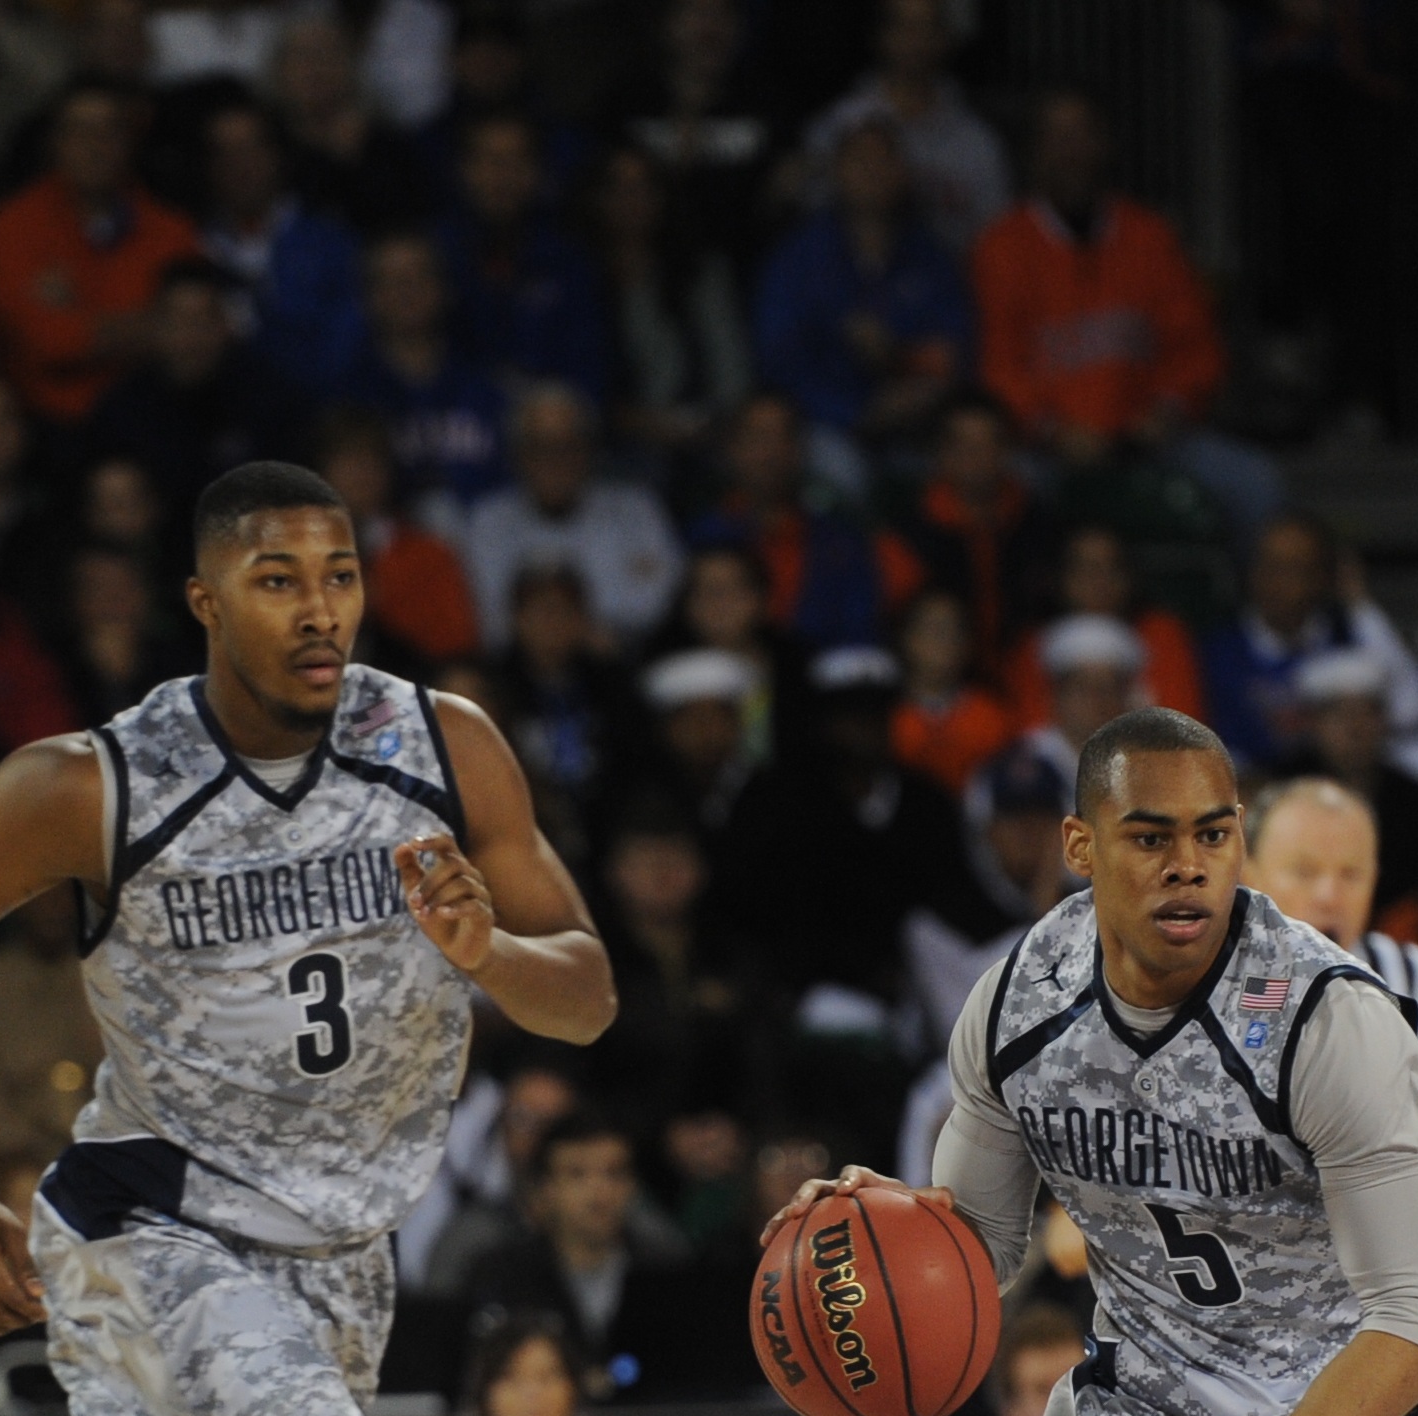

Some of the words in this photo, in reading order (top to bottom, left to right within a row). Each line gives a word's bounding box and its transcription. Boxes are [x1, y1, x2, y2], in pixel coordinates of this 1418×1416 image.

[161, 846, 408, 951] GEORGETOW
[287, 953, 353, 1078] 3
[1018, 1106, 1282, 1197] GEORGETOWN
[809, 1219, 878, 1392] Wilson
[1141, 1202, 1245, 1308] 5
[761, 1271, 807, 1388] NCAA
